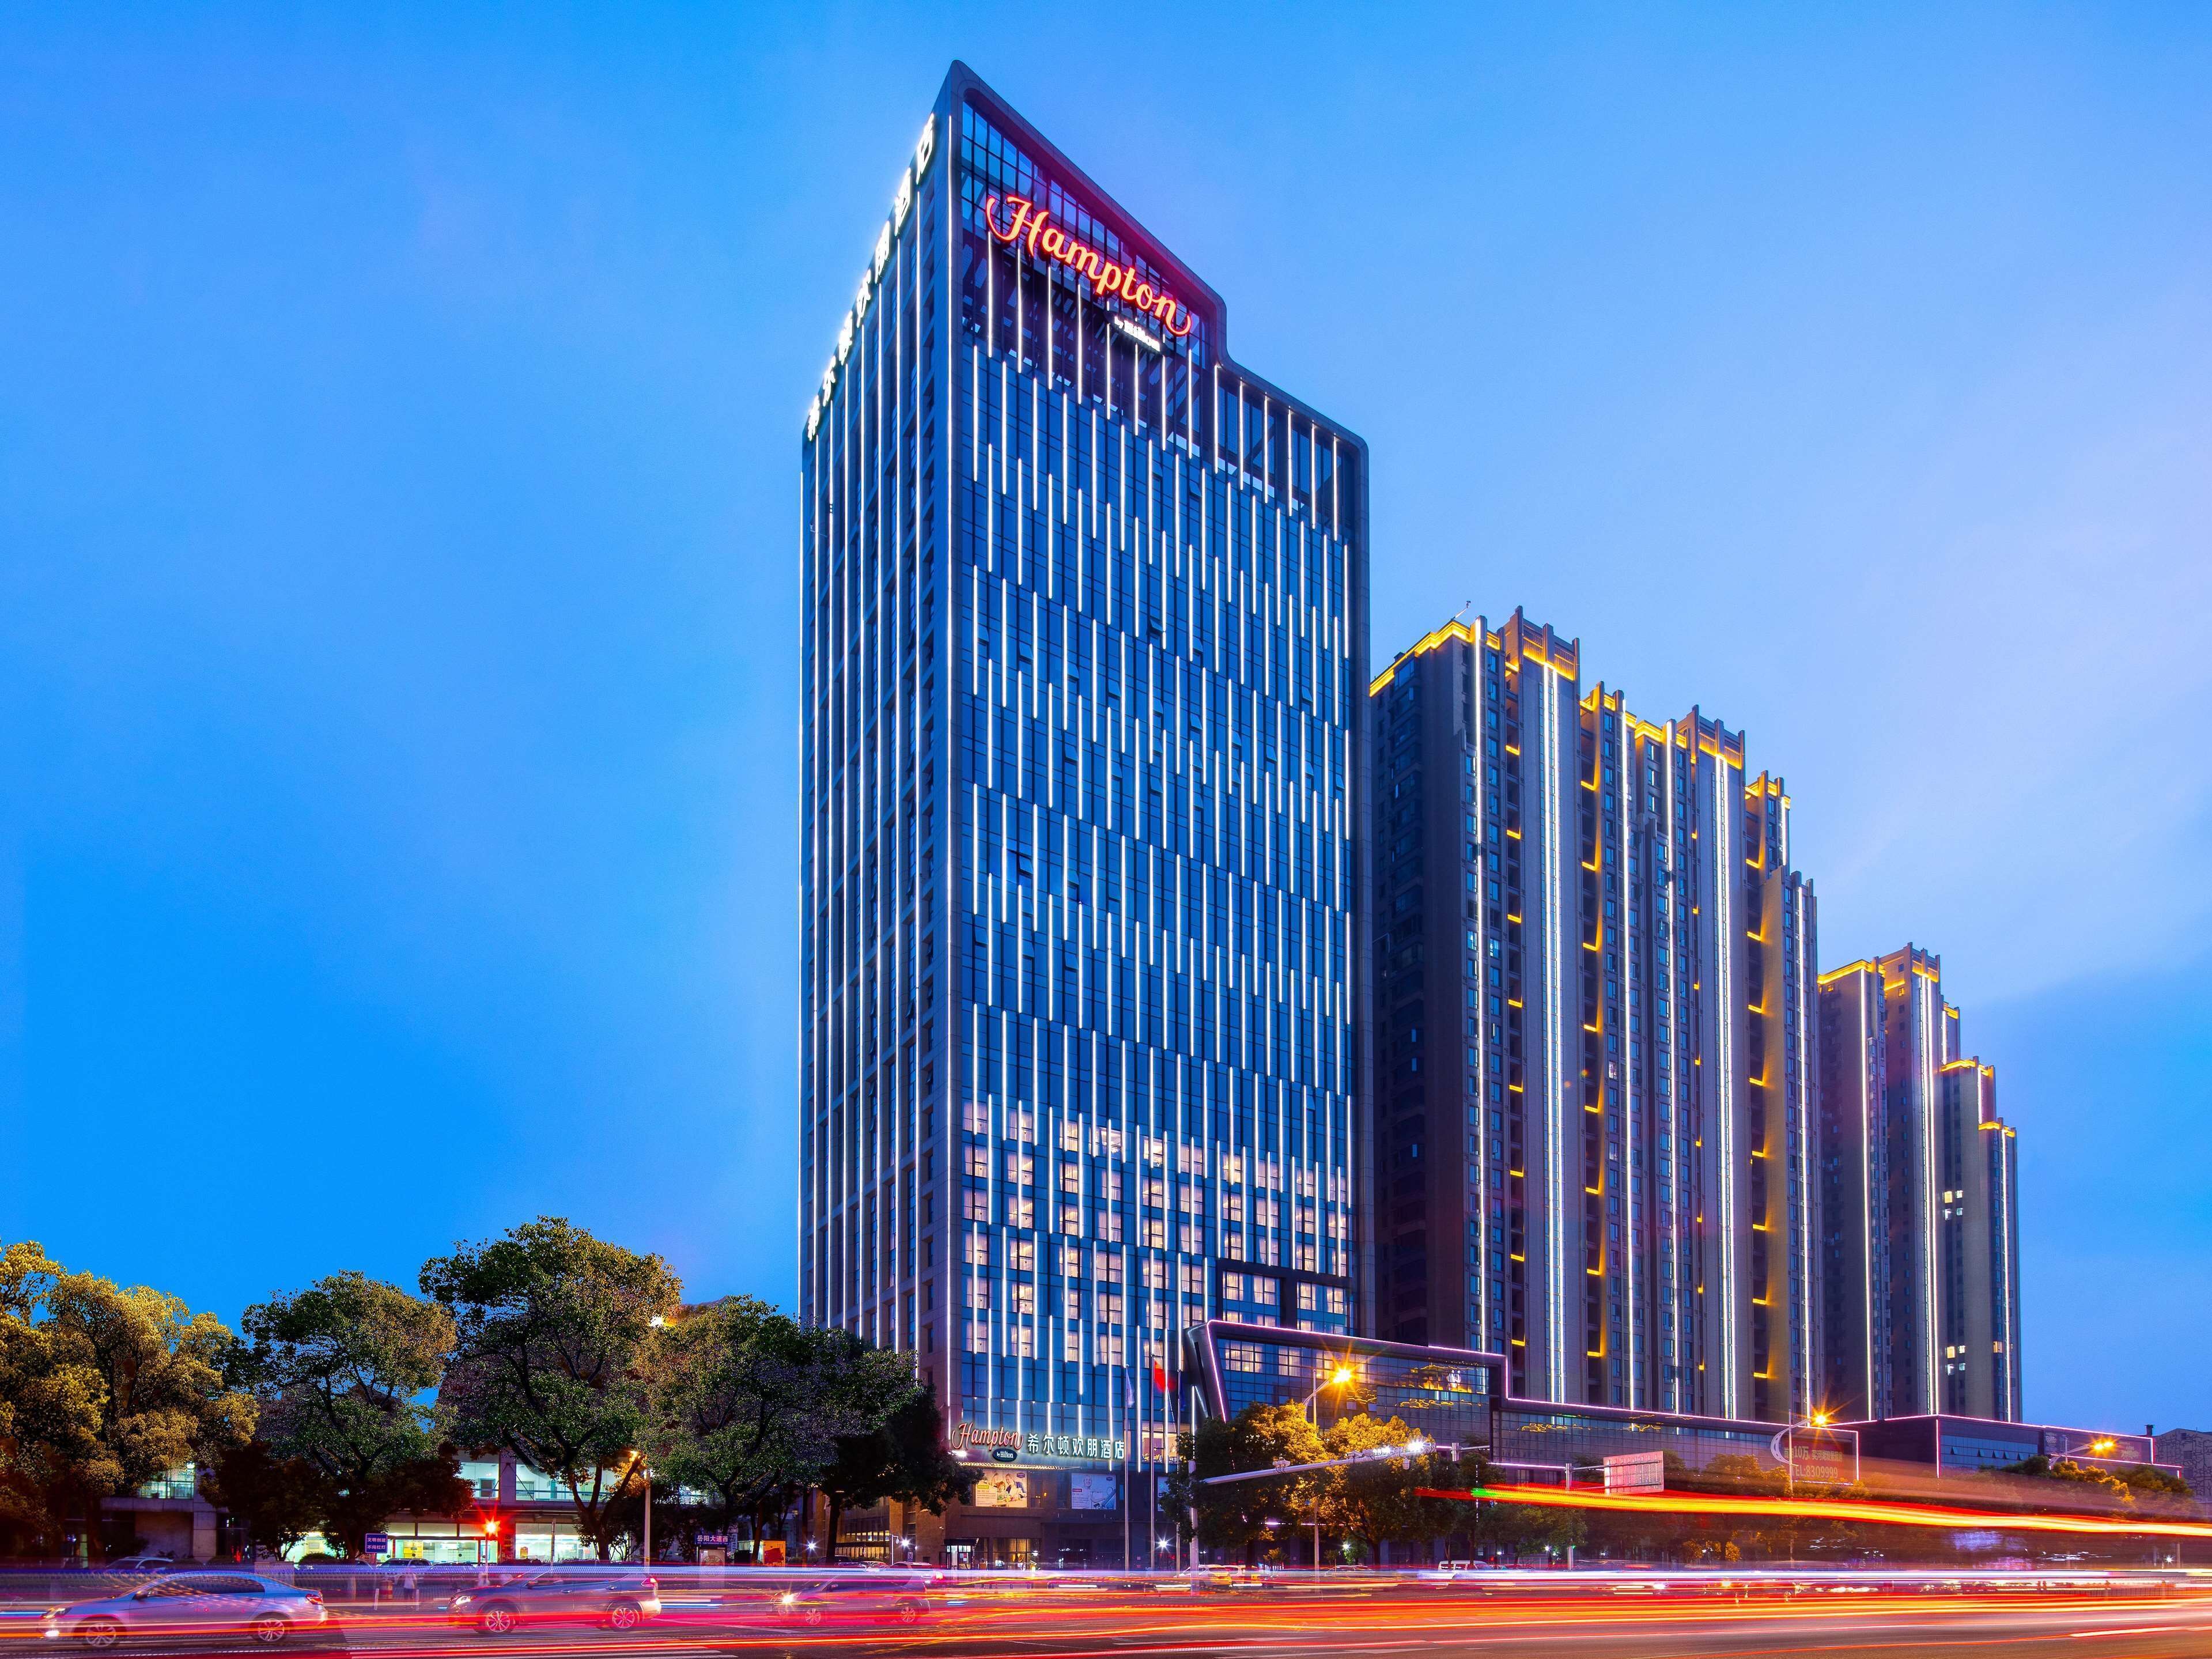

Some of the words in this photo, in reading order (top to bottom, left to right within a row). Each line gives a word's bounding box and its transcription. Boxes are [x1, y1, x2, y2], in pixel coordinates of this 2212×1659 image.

[985, 195, 1192, 336] Hampton
[952, 1422, 1024, 1451] Hampton
[1027, 1433, 1125, 1459] 希尔顿欢朋酒店
